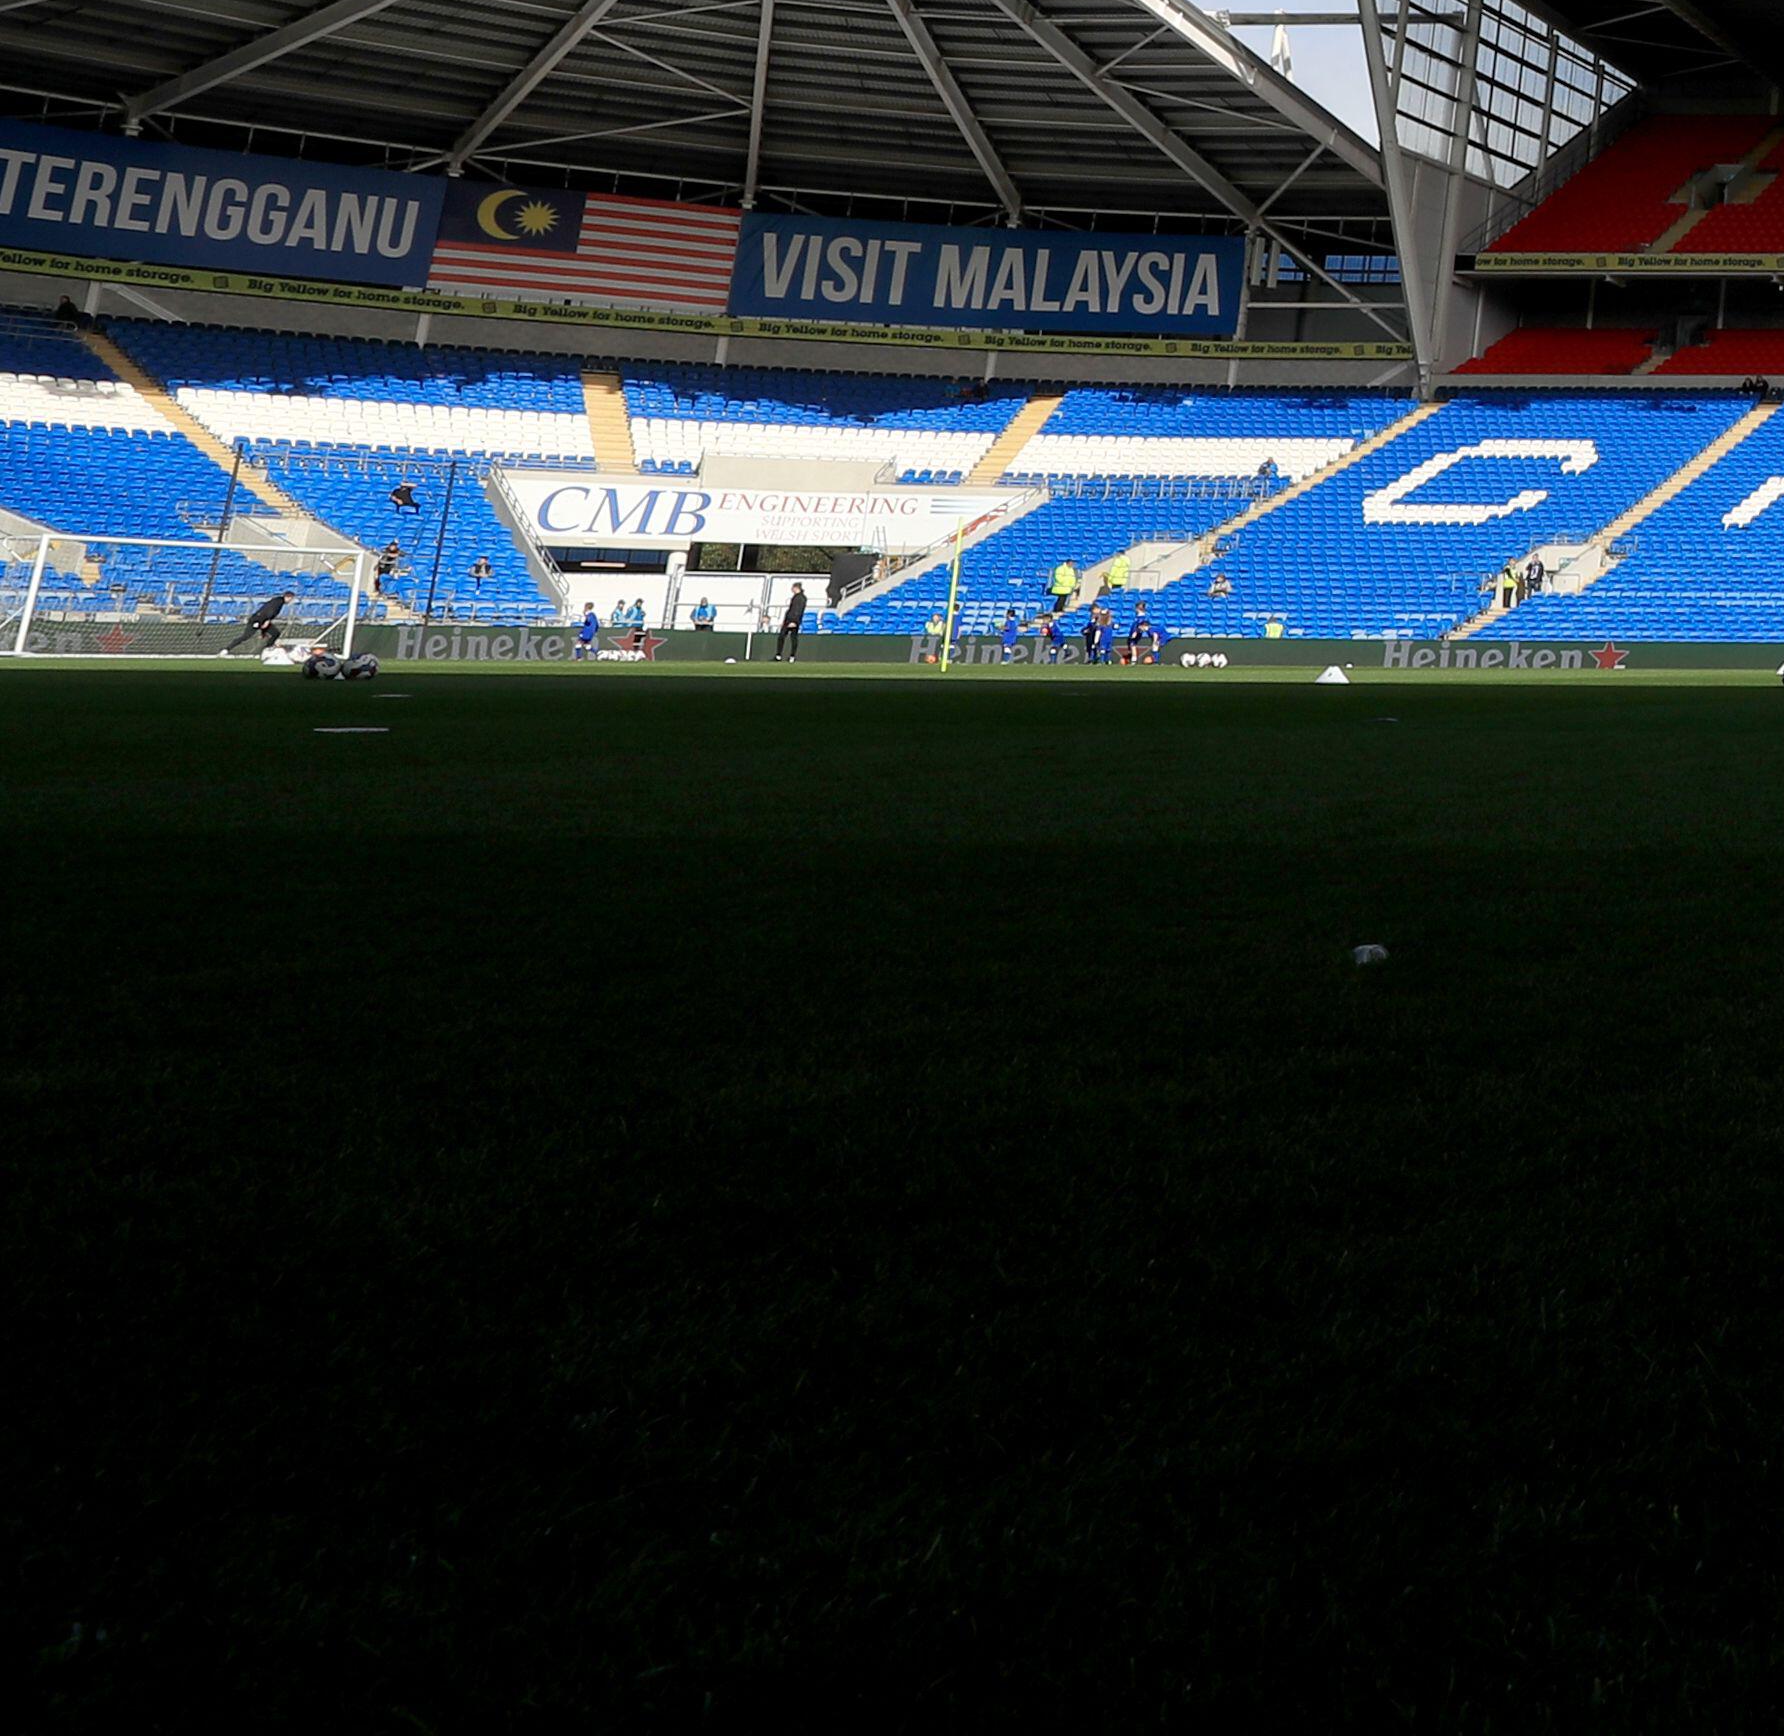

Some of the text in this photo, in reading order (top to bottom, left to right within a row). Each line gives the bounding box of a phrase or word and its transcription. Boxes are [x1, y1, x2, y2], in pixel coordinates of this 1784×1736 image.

[0, 148, 420, 259] TERENGGANU
[50, 258, 69, 269] for
[73, 261, 122, 274] home
[126, 268, 194, 284] storage.
[1510, 257, 1539, 265] home
[763, 232, 1220, 316] VISIT MALAYSIA
[248, 278, 273, 292] Big
[279, 282, 329, 294] Yellow
[332, 286, 350, 298] for
[357, 289, 400, 303] home
[513, 304, 536, 316] Big
[543, 306, 586, 318] Yellow
[592, 310, 610, 320] for
[615, 311, 654, 324] home
[759, 323, 780, 334] Big
[785, 324, 827, 335] Yellow
[830, 327, 848, 337] for
[850, 328, 888, 338] home
[984, 335, 1004, 345] Big
[1009, 336, 1047, 346] Yellow
[1050, 338, 1065, 347] for
[1068, 338, 1101, 348] home
[537, 486, 711, 537] CMB
[717, 492, 918, 515] ENGINEERING
[761, 515, 859, 529] SUPPORTING
[754, 528, 862, 543] WELSH SPORT
[1383, 641, 1583, 668] Heineken
